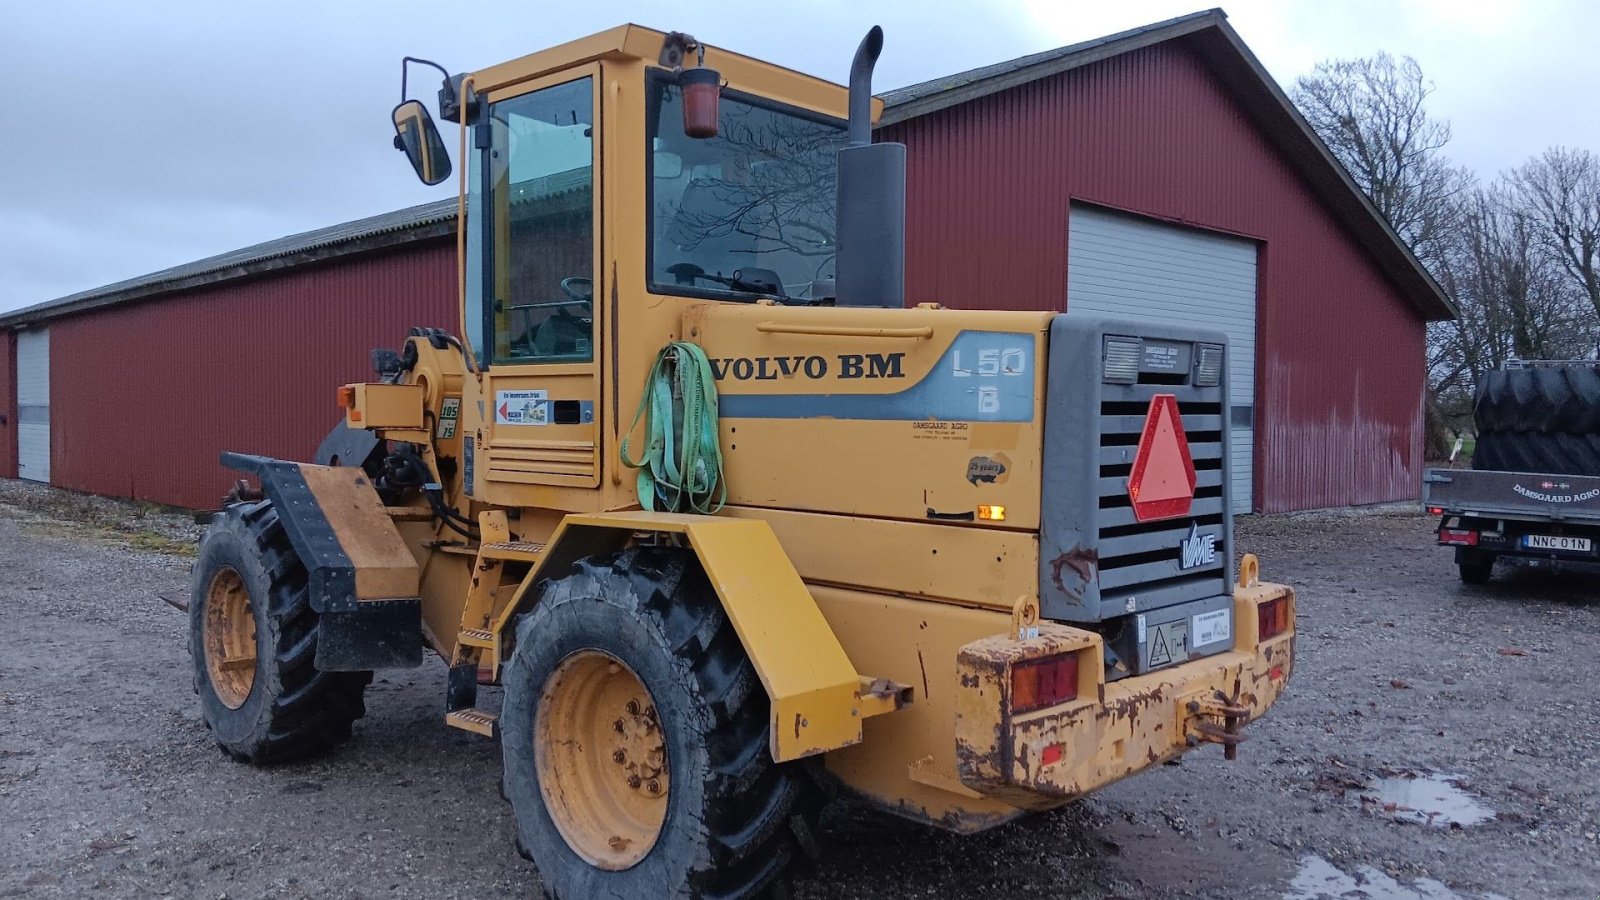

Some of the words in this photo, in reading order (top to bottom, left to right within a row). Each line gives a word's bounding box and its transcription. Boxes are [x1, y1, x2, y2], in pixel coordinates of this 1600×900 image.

[708, 355, 828, 380] VOLVO
[837, 353, 905, 379] BM
[953, 351, 971, 377] L
[978, 348, 1025, 376] 50
[978, 386, 1000, 412] B
[442, 406, 458, 417] 105
[443, 427, 453, 438] 75
[970, 462, 979, 470] 25
[1513, 484, 1571, 502] DAMSGAARD
[1574, 488, 1600, 501] AGRO
[1182, 523, 1215, 568] VME
[1533, 536, 1557, 547] NNC
